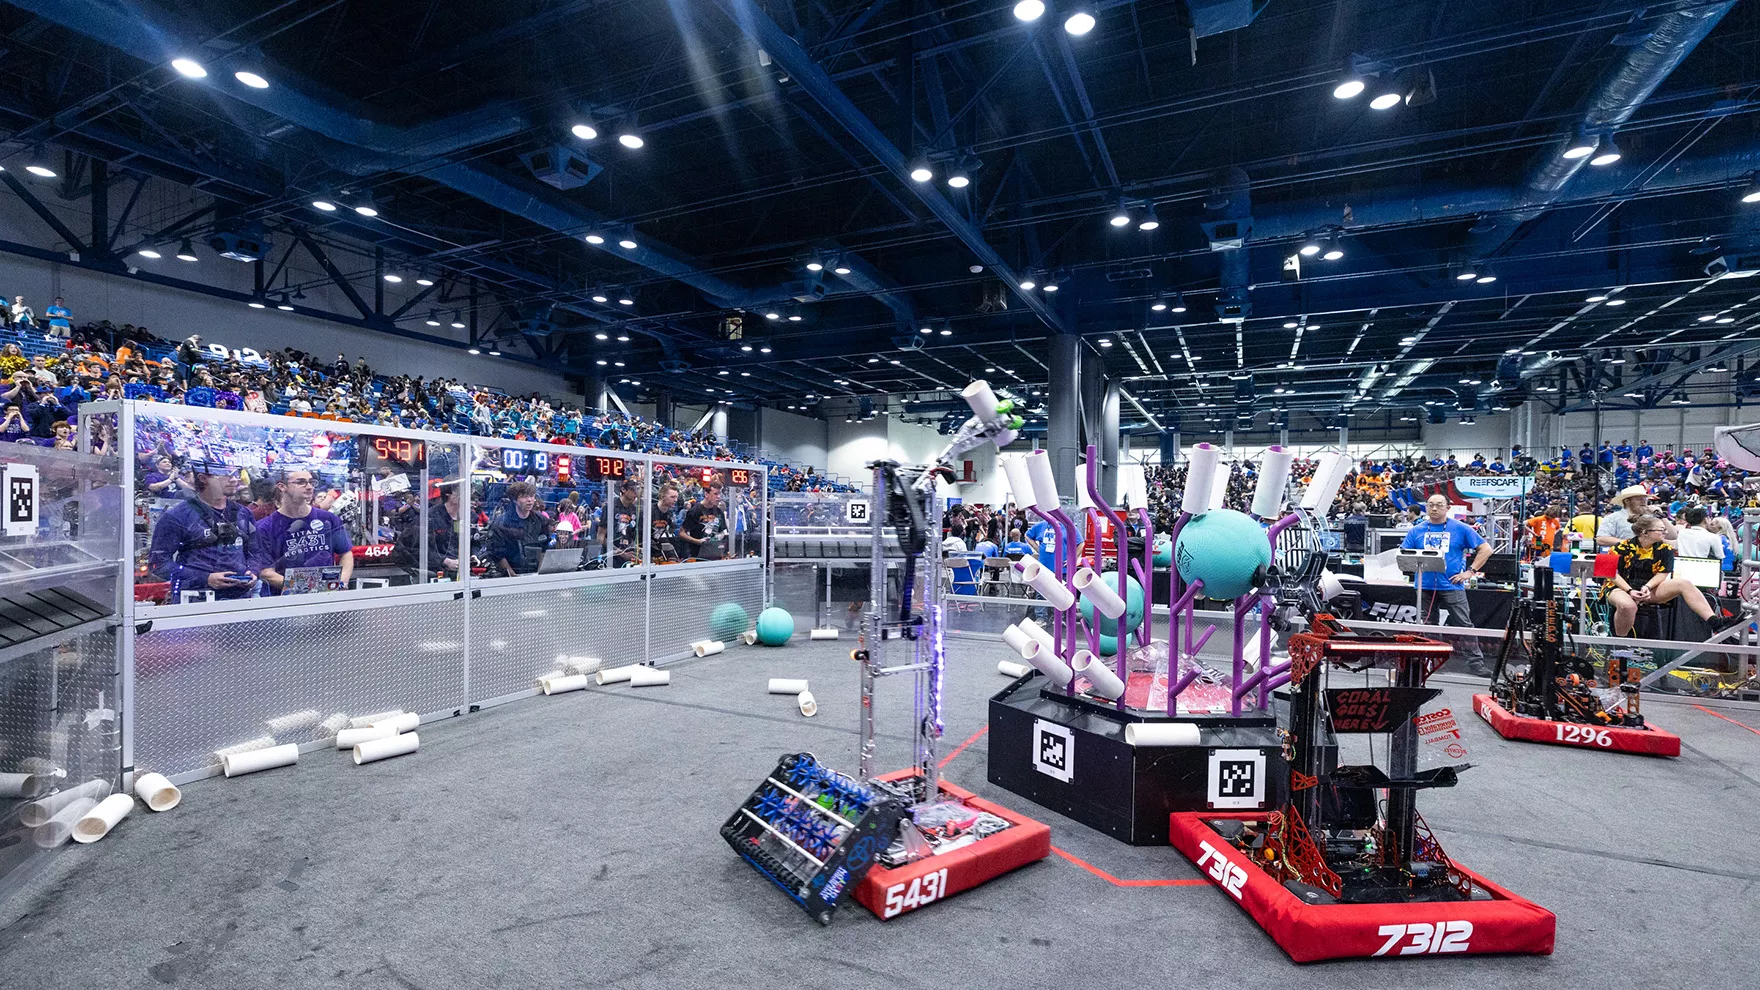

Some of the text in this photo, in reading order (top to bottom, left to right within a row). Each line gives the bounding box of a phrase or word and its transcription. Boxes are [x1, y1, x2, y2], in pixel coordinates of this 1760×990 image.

[376, 438, 423, 461] 5431
[504, 450, 548, 471] 00:19
[596, 458, 623, 476] 7312
[1470, 478, 1518, 487] REEFSCAPE
[291, 529, 319, 538] TITAN
[284, 544, 330, 557] ROBOTICS
[286, 534, 326, 551] 5431
[1336, 690, 1391, 704] CORAL
[1335, 704, 1378, 717] GOES
[1334, 718, 1369, 730] HERE
[1555, 723, 1612, 747] 1296
[1196, 840, 1248, 900] 7312
[884, 868, 948, 918] 5431
[1371, 920, 1473, 957] 7312
